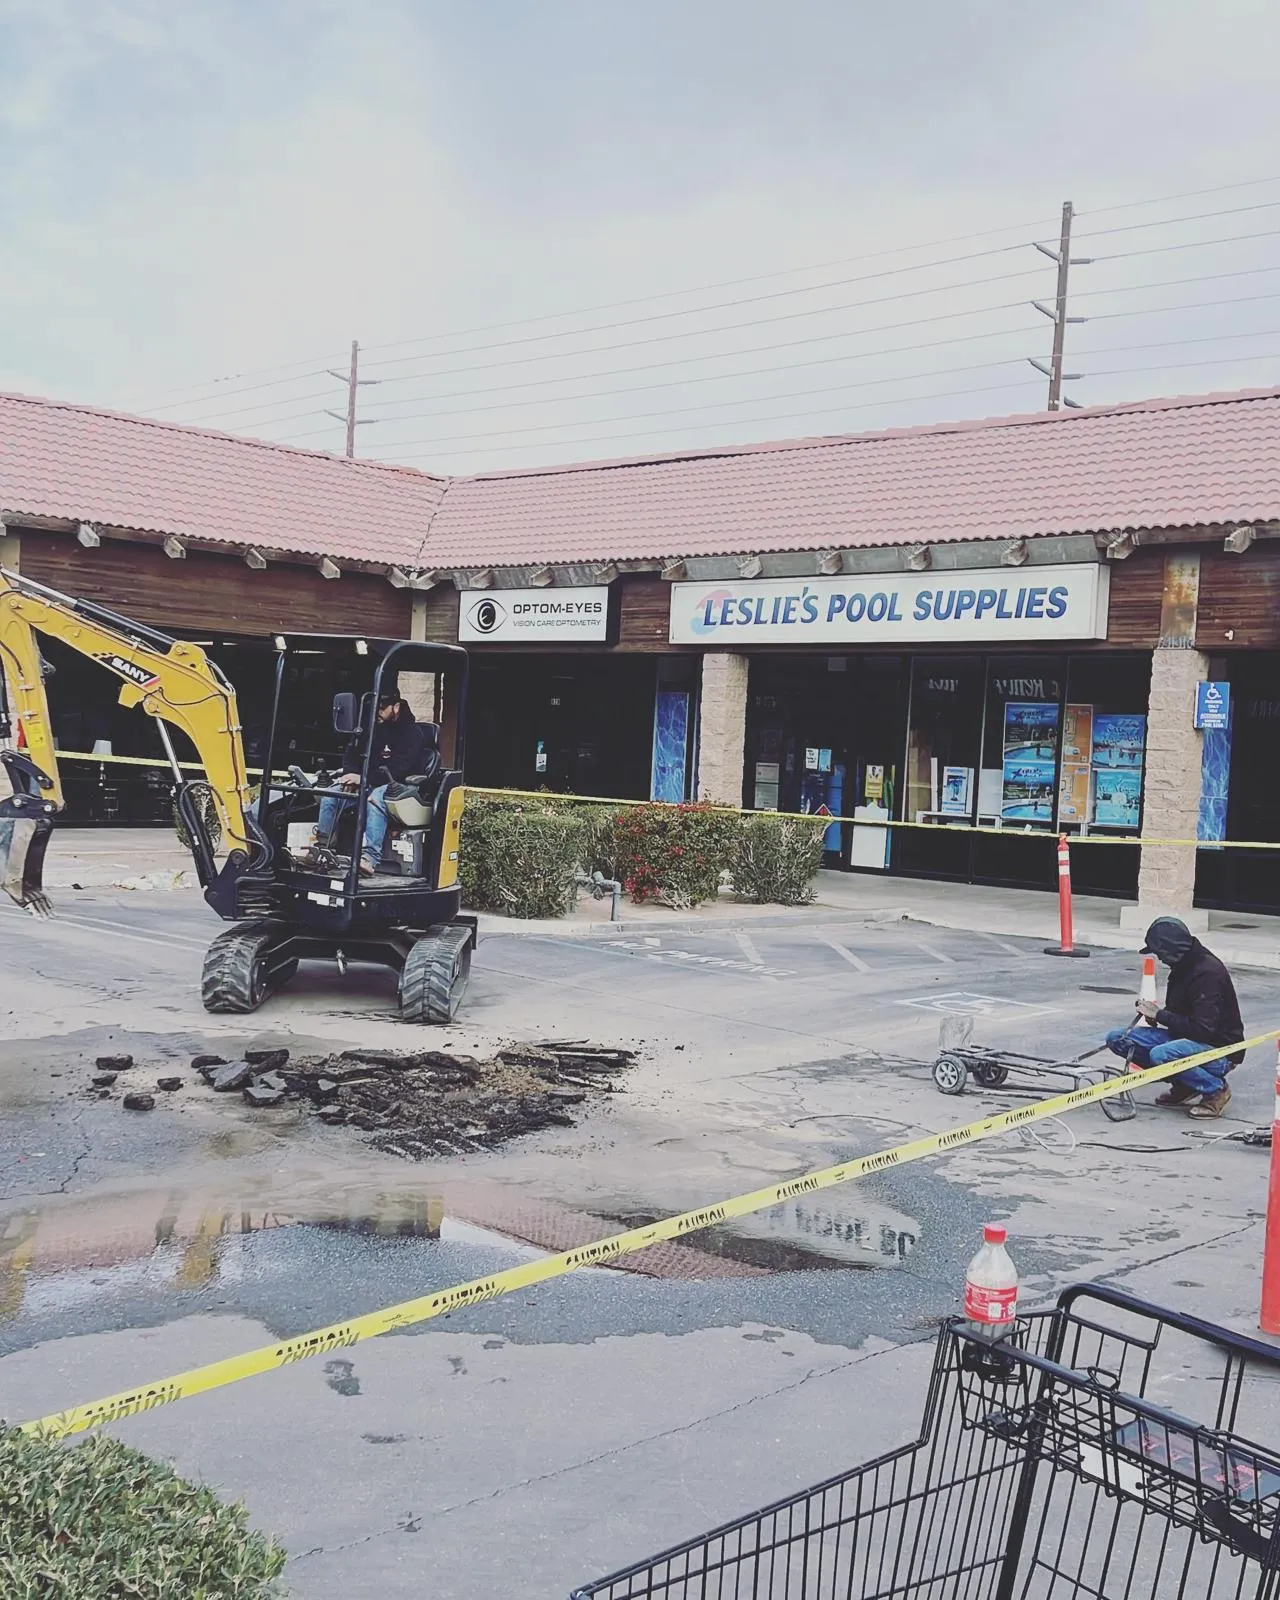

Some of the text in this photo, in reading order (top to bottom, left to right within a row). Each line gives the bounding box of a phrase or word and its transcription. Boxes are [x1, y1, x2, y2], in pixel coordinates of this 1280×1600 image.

[513, 602, 603, 614] OPTOM-EYES
[703, 586, 1069, 626] LESLIE'S POOL SUPPLIES
[555, 619, 602, 627] OPTOMETRY
[111, 657, 151, 682] SANY
[776, 1178, 819, 1200] CAUTION
[677, 1207, 727, 1231] CAUTION
